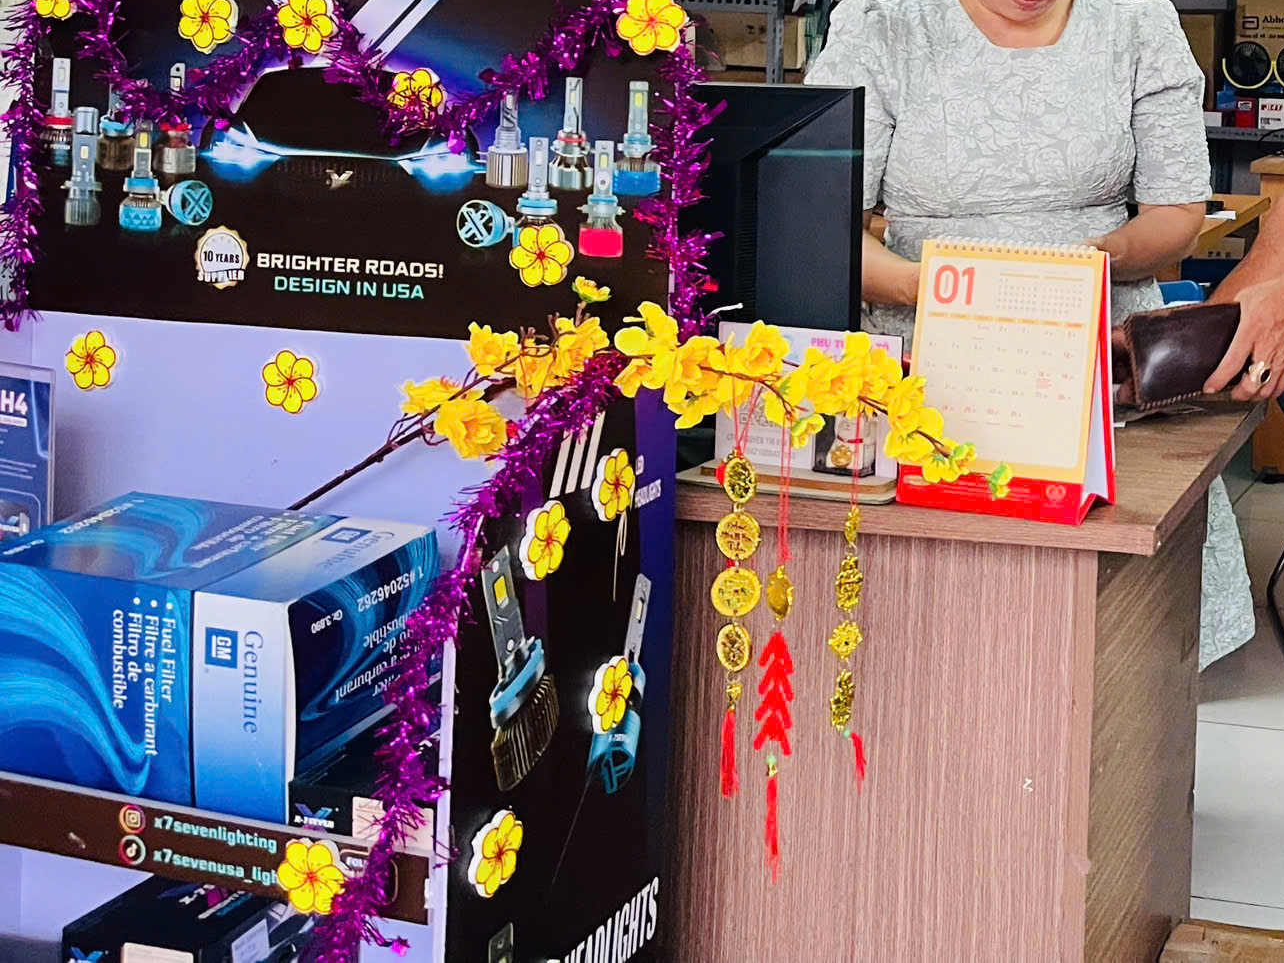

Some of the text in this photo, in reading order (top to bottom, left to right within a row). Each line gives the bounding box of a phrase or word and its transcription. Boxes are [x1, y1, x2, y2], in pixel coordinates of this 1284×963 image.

[204, 250, 240, 264] 10 YEARS
[257, 253, 444, 278] BRIGHTER ROADS!
[274, 276, 424, 299] DESIGN IN USA
[934, 264, 975, 306] 01
[0, 389, 28, 415] H4
[112, 609, 128, 709] combustible
[127, 612, 143, 683] Filtro de
[161, 617, 176, 703] Fuel Filter
[214, 635, 233, 662] GM
[144, 615, 159, 756] Filtre a carburant
[244, 630, 264, 734] Genuine
[154, 814, 278, 853] x7sevenlighting
[153, 849, 280, 886] x7sevenusa_ligh
